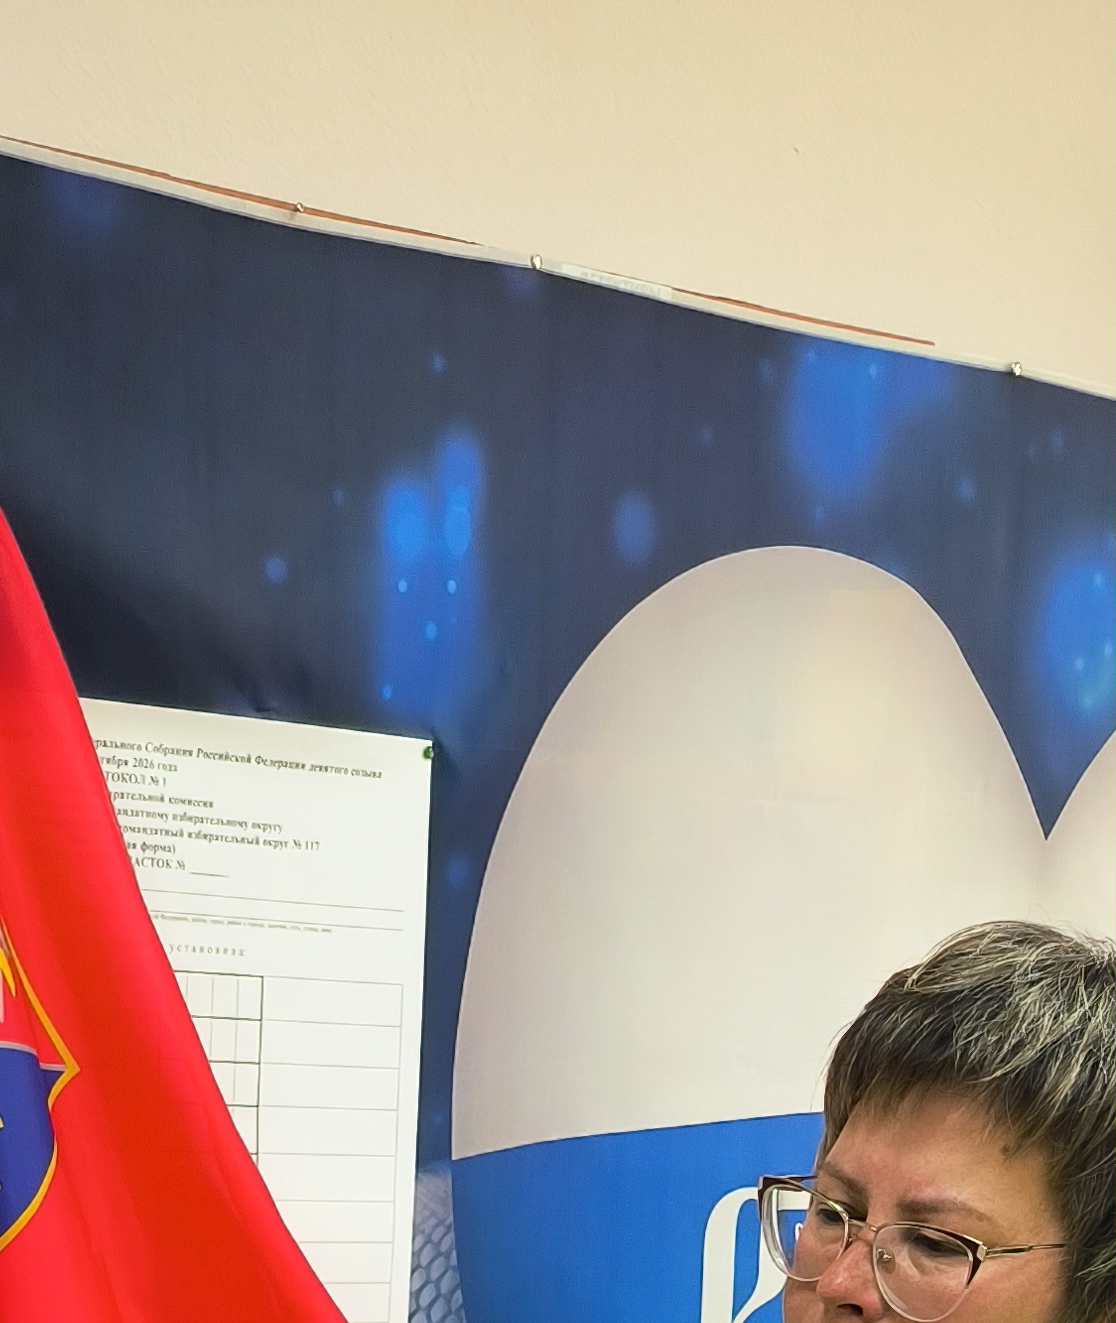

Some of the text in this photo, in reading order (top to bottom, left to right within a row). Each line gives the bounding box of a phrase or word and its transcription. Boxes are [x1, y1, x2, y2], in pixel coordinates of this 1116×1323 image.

[94, 739, 142, 752] рального
[110, 790, 166, 803] рательной
[119, 824, 185, 839] омандатный
